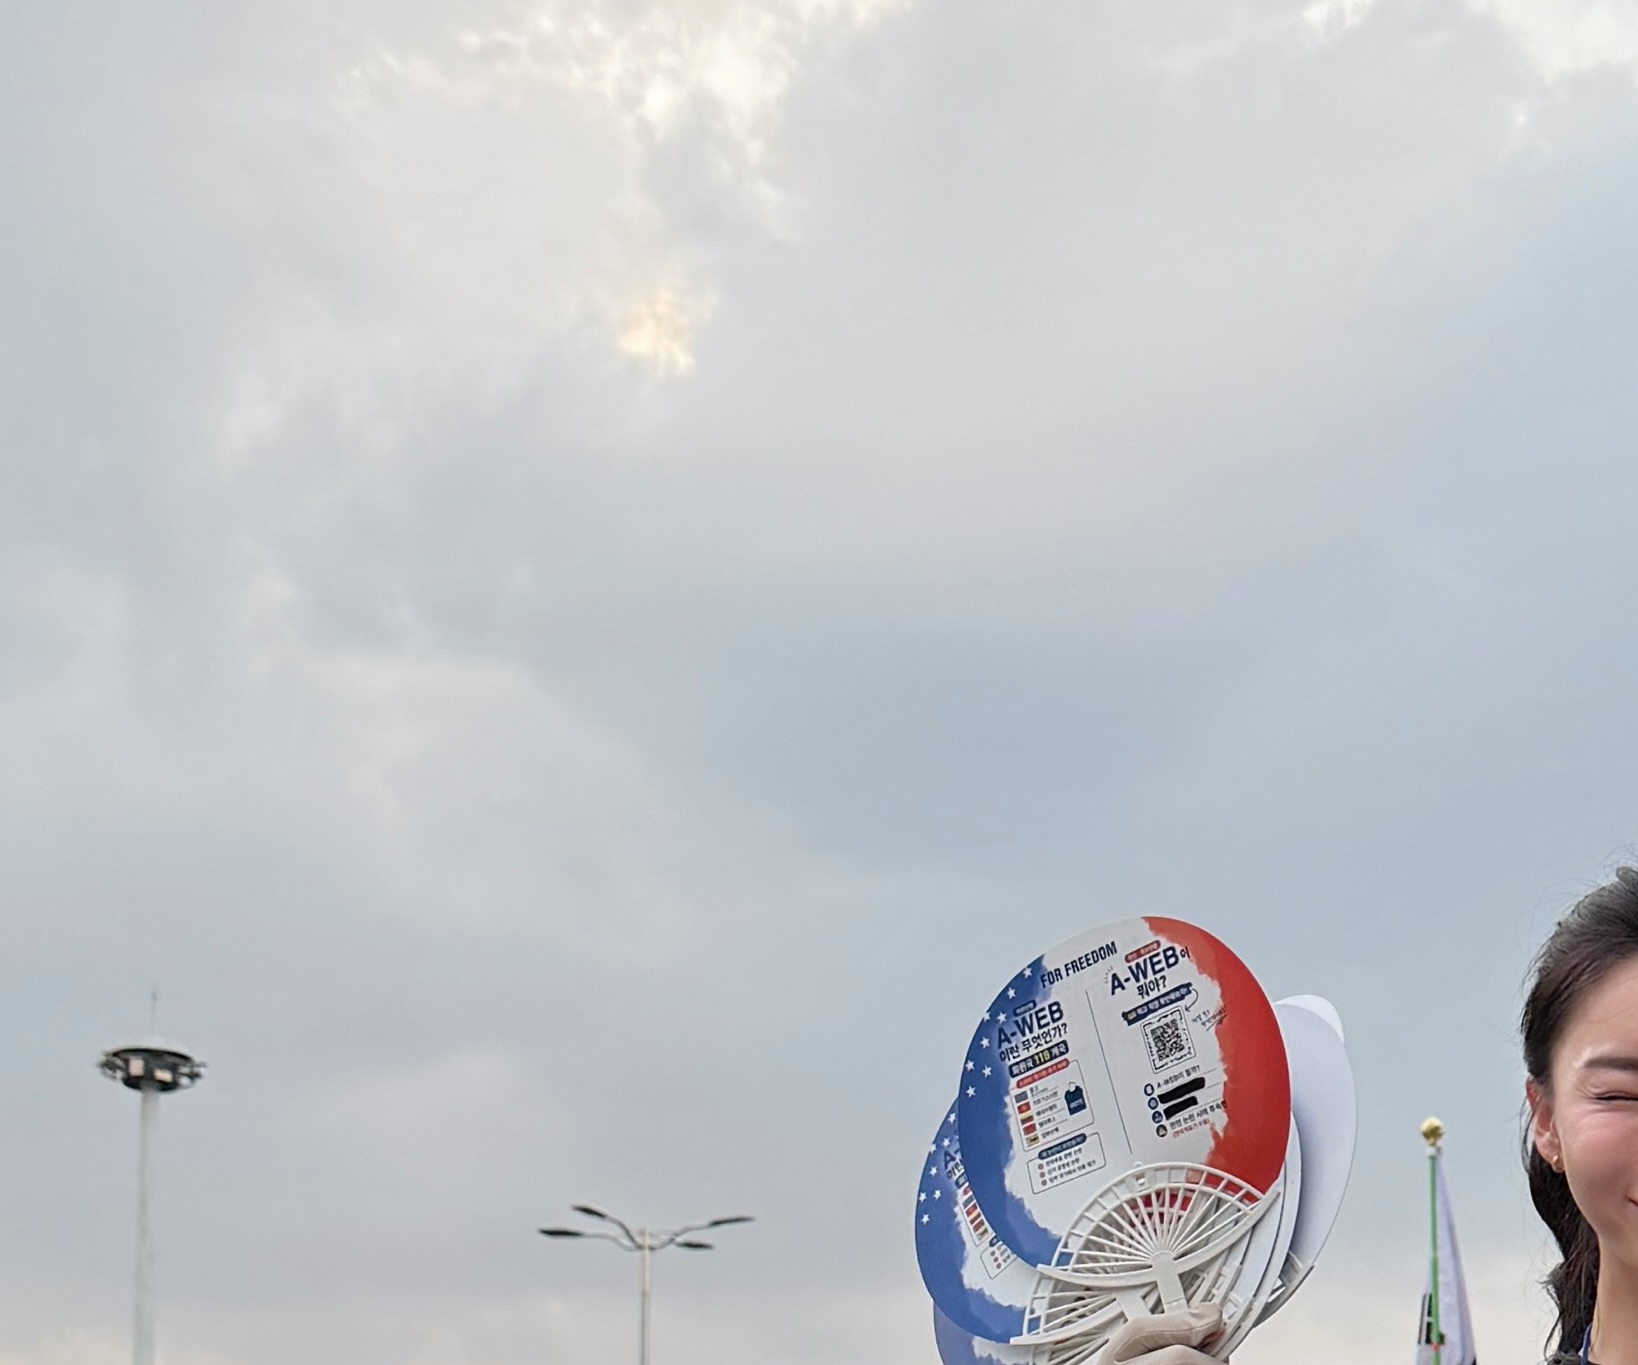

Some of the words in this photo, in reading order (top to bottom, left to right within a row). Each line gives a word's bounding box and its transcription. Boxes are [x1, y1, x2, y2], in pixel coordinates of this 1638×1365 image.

[1040, 968, 1063, 988] FOR
[1064, 941, 1118, 977] FREEDOM
[997, 1000, 1064, 1049] A-WEB
